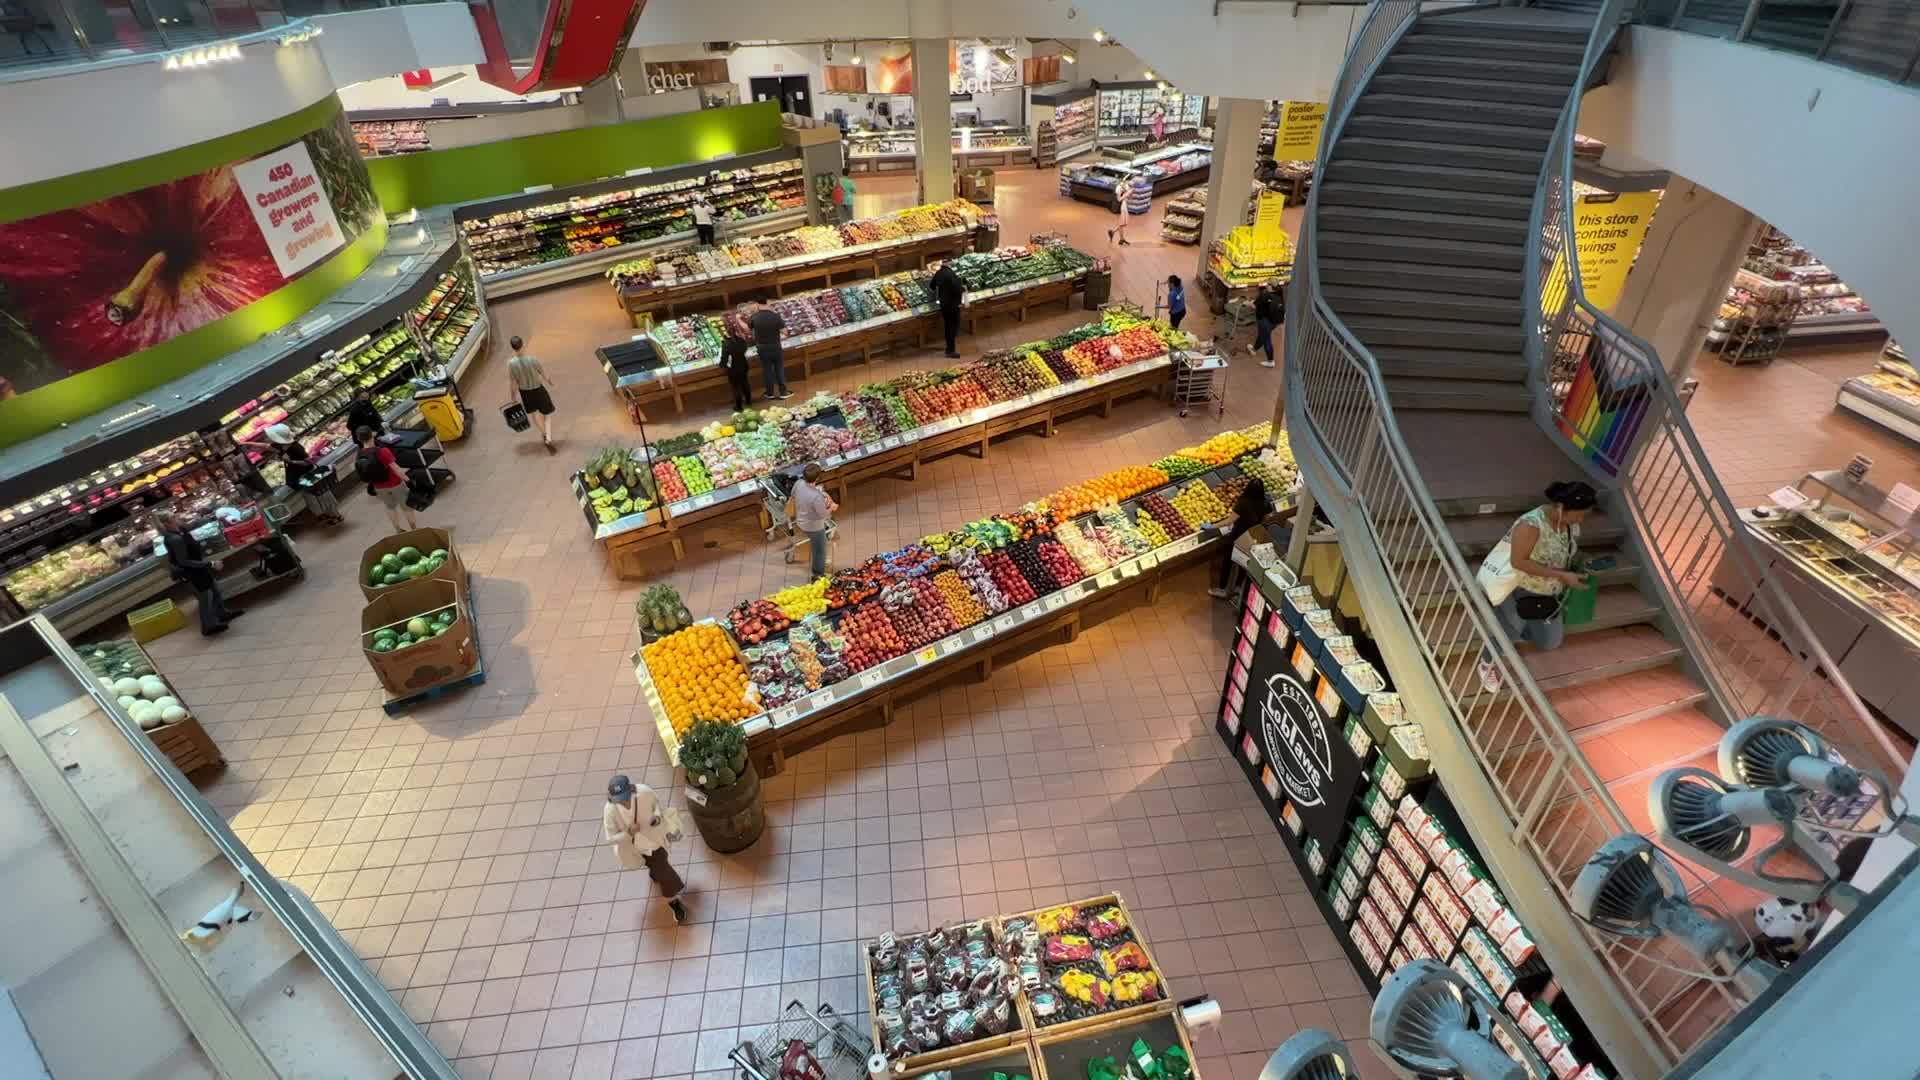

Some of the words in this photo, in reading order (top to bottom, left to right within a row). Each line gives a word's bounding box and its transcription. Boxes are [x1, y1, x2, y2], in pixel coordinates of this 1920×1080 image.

[269, 162, 293, 182] 450
[256, 174, 316, 208] Canadian
[268, 191, 320, 228] growers
[1579, 215, 1602, 226] this
[1604, 213, 1639, 225] store
[291, 210, 315, 233] and
[1575, 227, 1628, 239] contains
[286, 222, 334, 260] growing
[1577, 241, 1616, 254] avings
[1267, 690, 1321, 787] Loblaws
